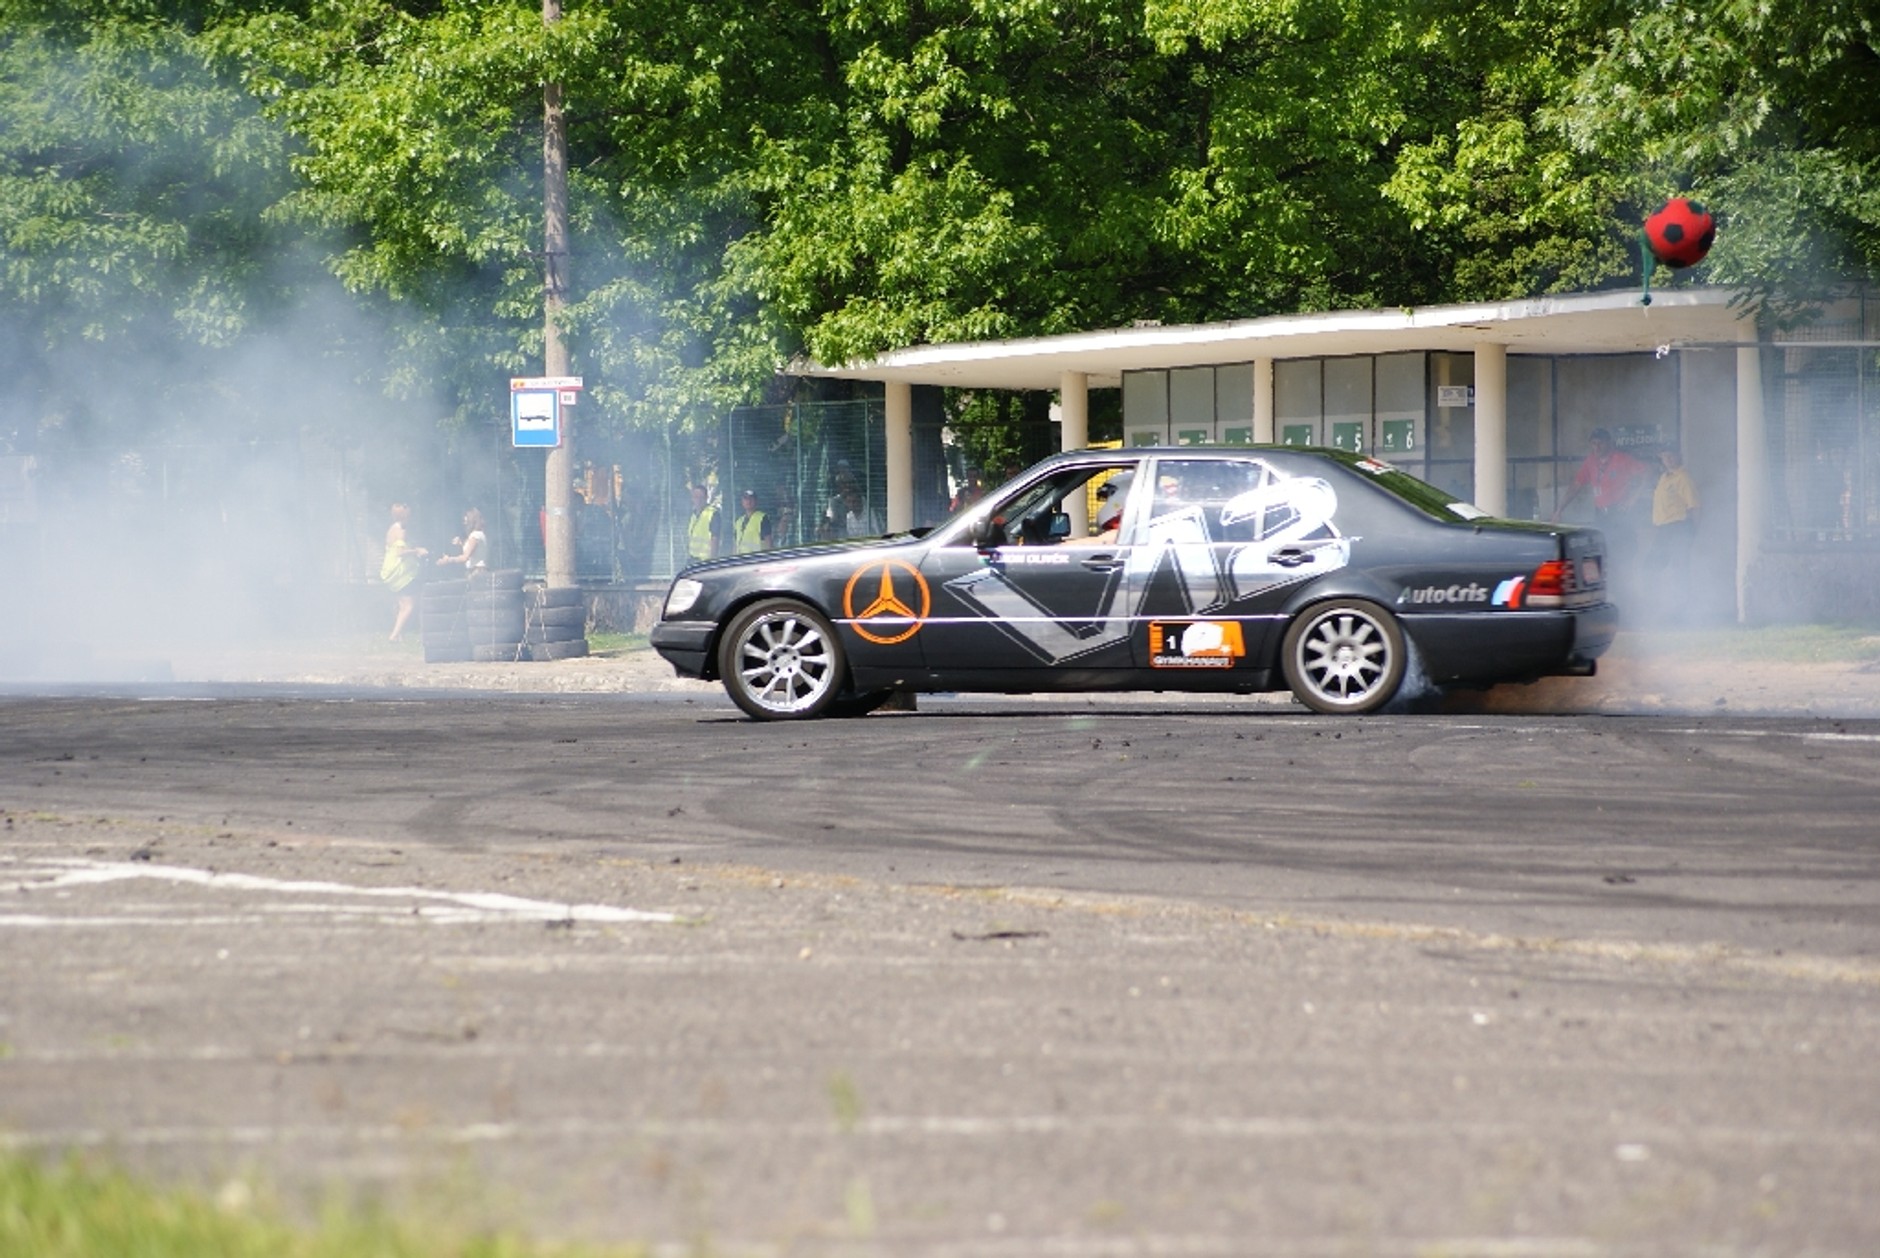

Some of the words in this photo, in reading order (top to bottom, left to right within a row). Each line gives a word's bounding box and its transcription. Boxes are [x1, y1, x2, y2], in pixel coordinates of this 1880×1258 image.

[1355, 433, 1361, 453] 5
[1406, 431, 1413, 449] 6
[1396, 582, 1489, 604] AutoCris
[1166, 635, 1176, 649] 1
